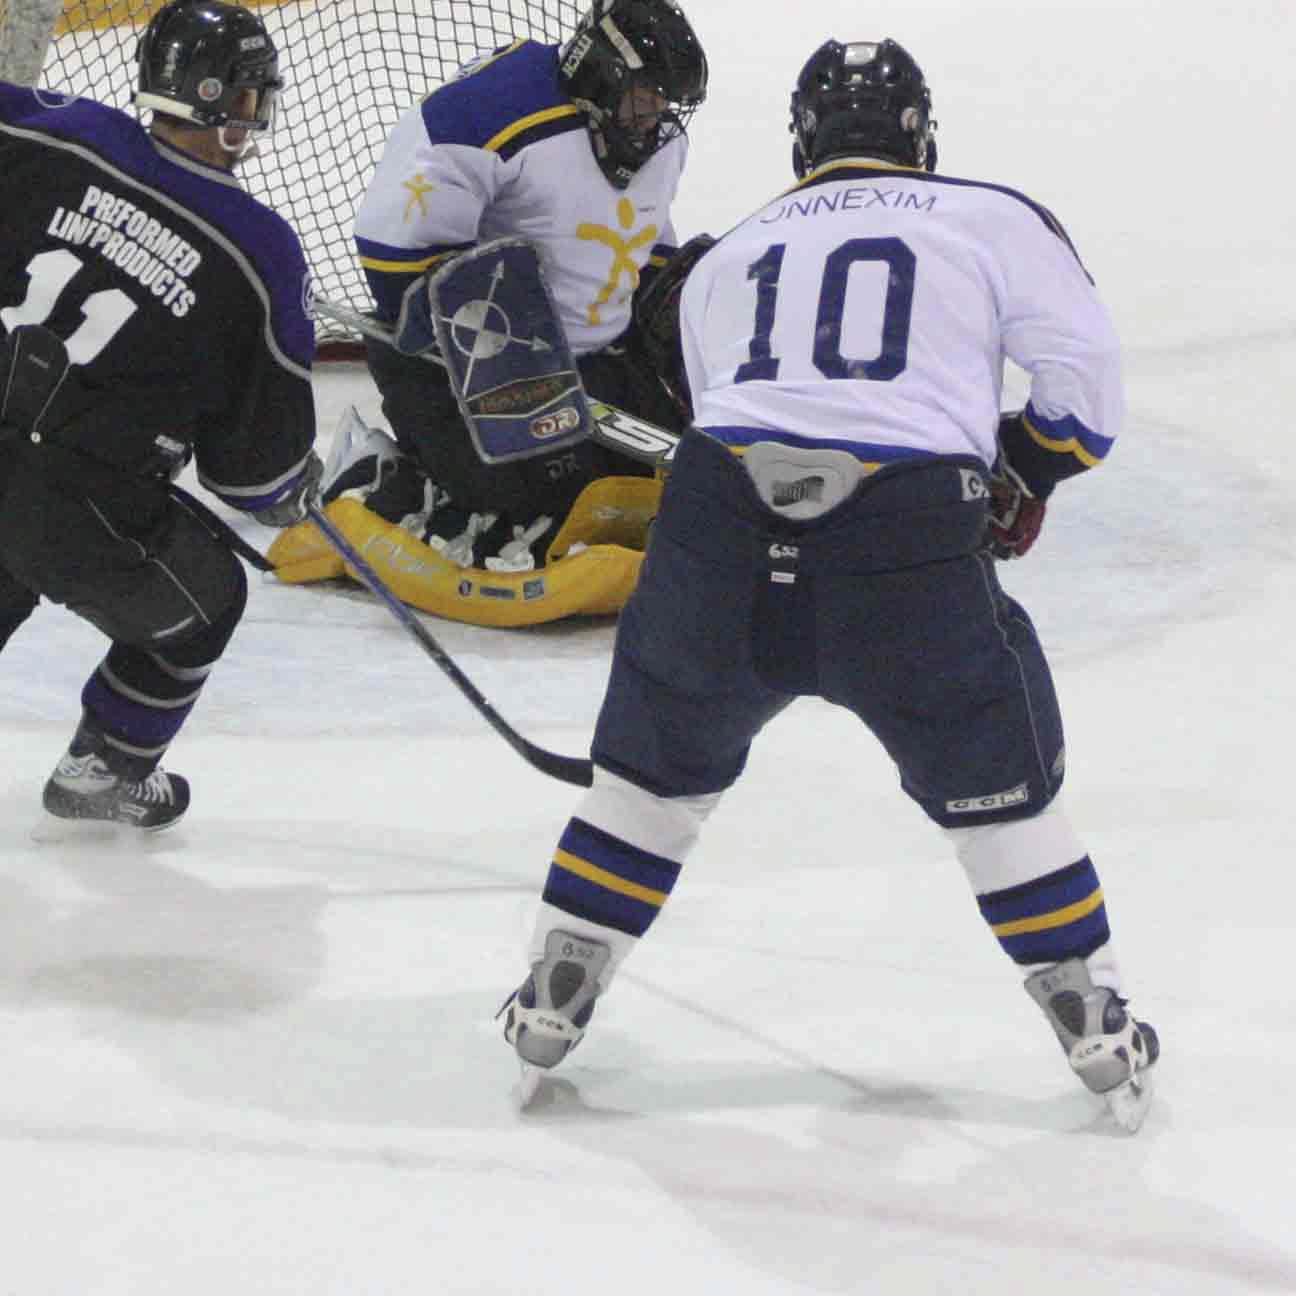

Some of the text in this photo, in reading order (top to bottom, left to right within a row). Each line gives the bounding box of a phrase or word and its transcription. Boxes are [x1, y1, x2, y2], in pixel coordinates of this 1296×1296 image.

[0, 248, 139, 366] 11
[88, 220, 197, 318] PRODUCTS
[733, 236, 918, 385] 10
